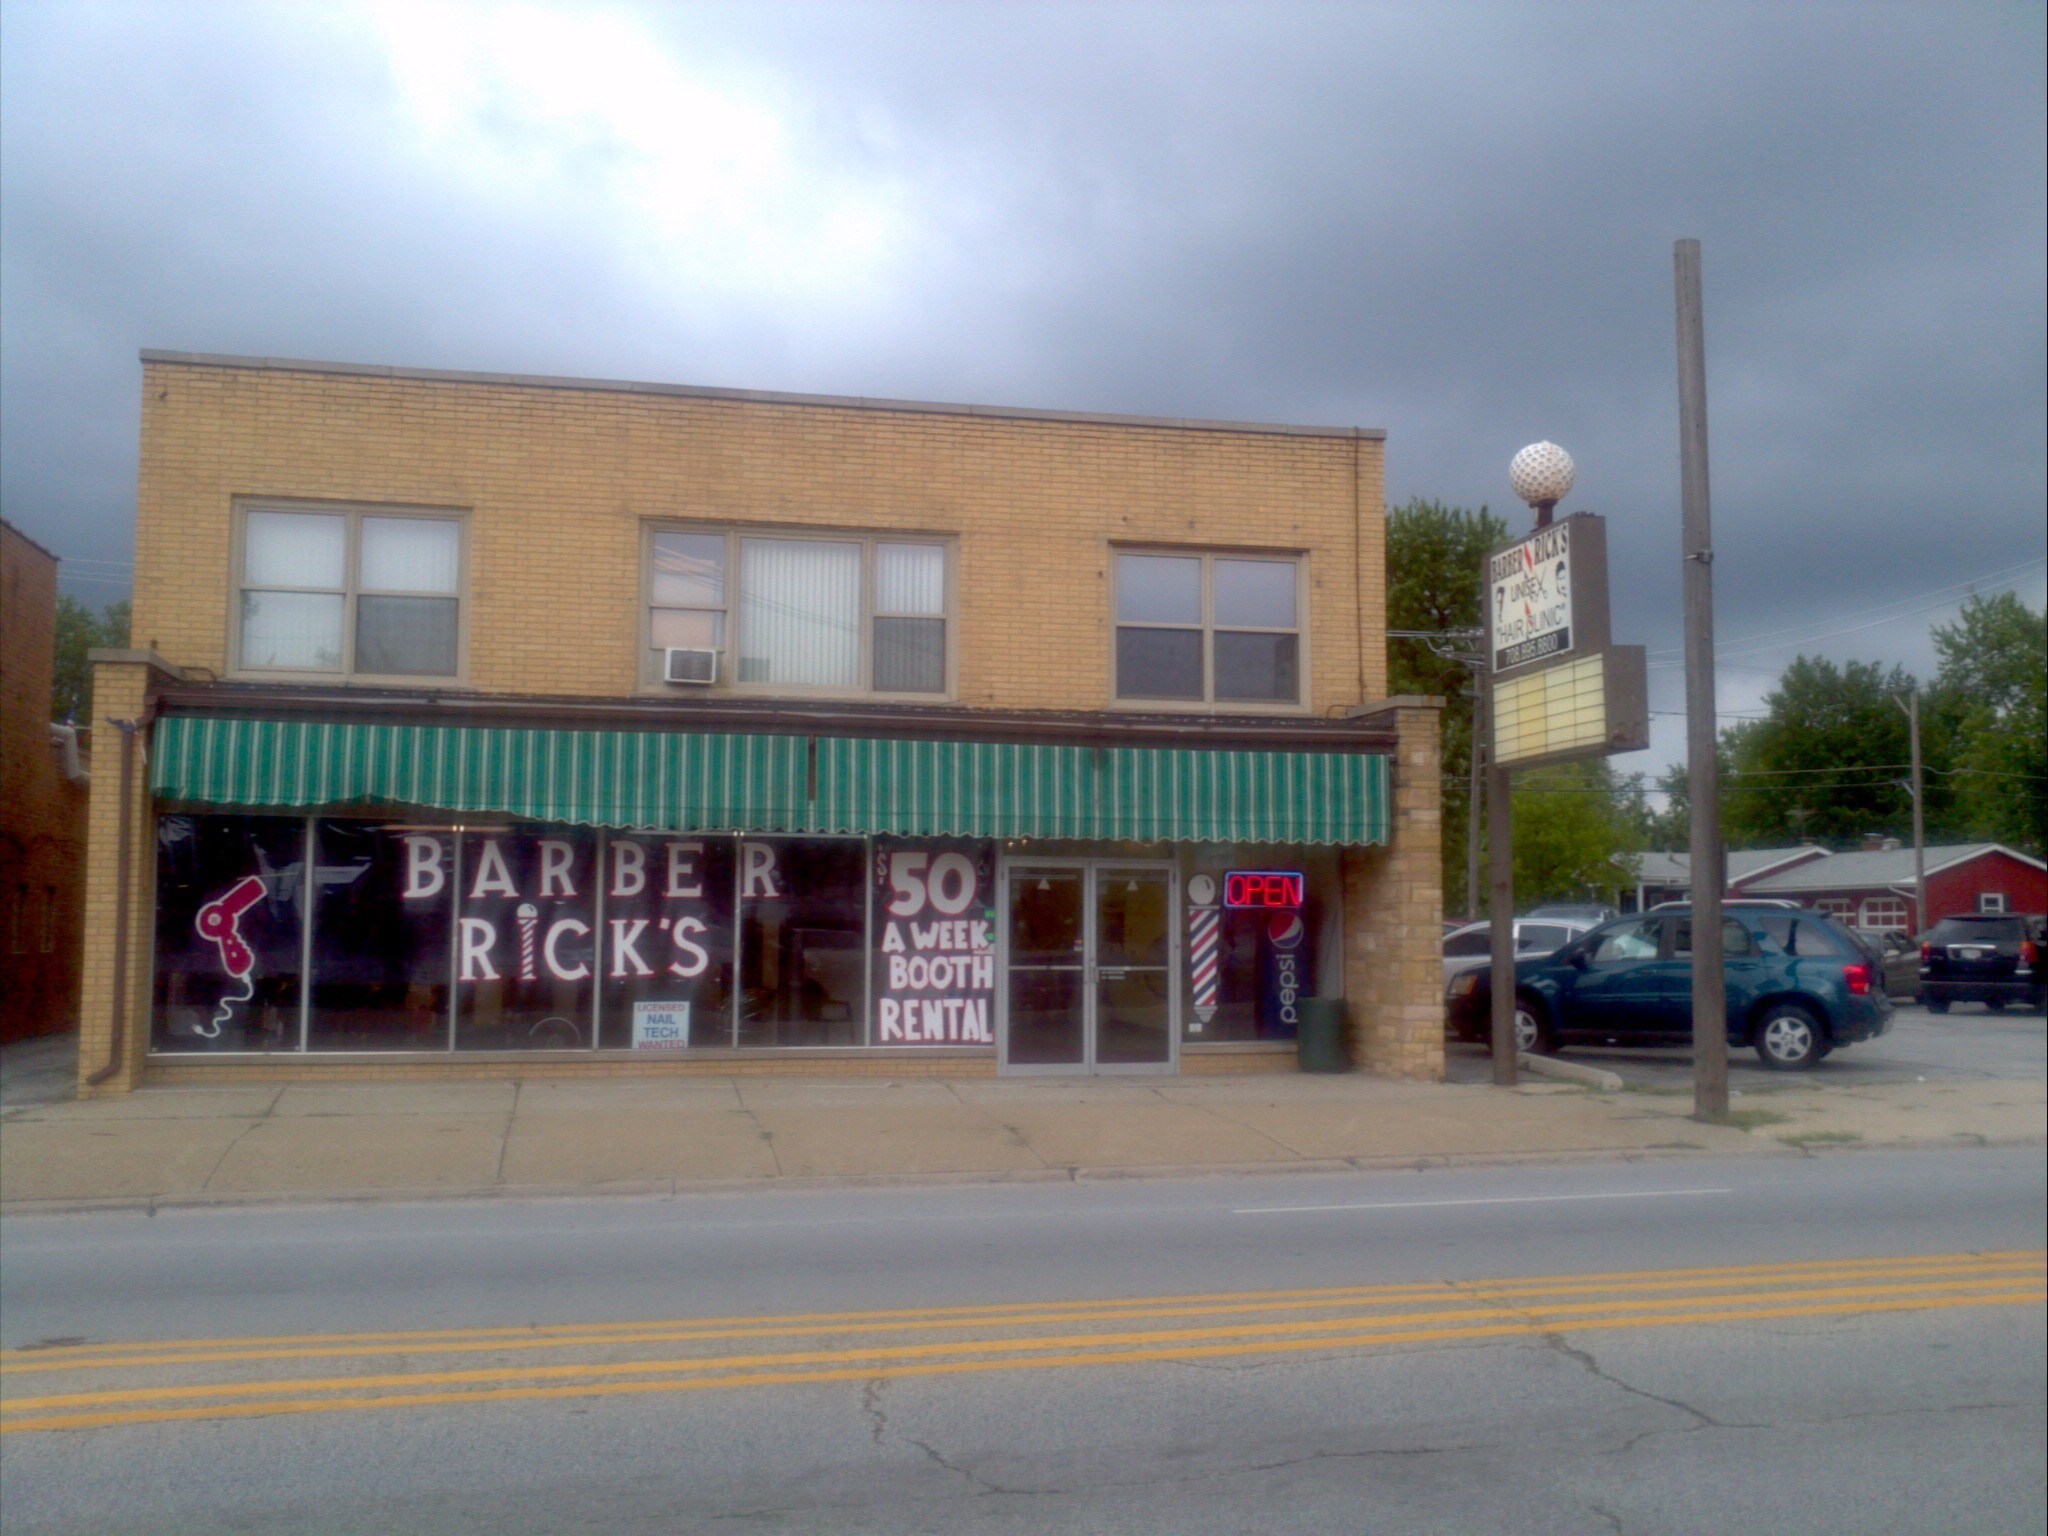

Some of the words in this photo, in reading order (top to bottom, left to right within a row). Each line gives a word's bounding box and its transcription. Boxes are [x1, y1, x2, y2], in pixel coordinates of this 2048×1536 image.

[1492, 549, 1523, 583] BARBER
[403, 836, 780, 899] BARBER
[1228, 875, 1301, 906] OPEN
[459, 903, 710, 981] RICK'S
[882, 921, 906, 953] A
[909, 920, 990, 951] WEEK
[890, 956, 994, 990] BOOTH
[1275, 954, 1298, 1023] pepsi
[638, 1003, 685, 1012] LICENSED
[647, 1013, 676, 1024] NAIL
[880, 998, 994, 1043] RENTAL
[638, 1039, 685, 1050] WANTED
[644, 1027, 679, 1038] TECH
